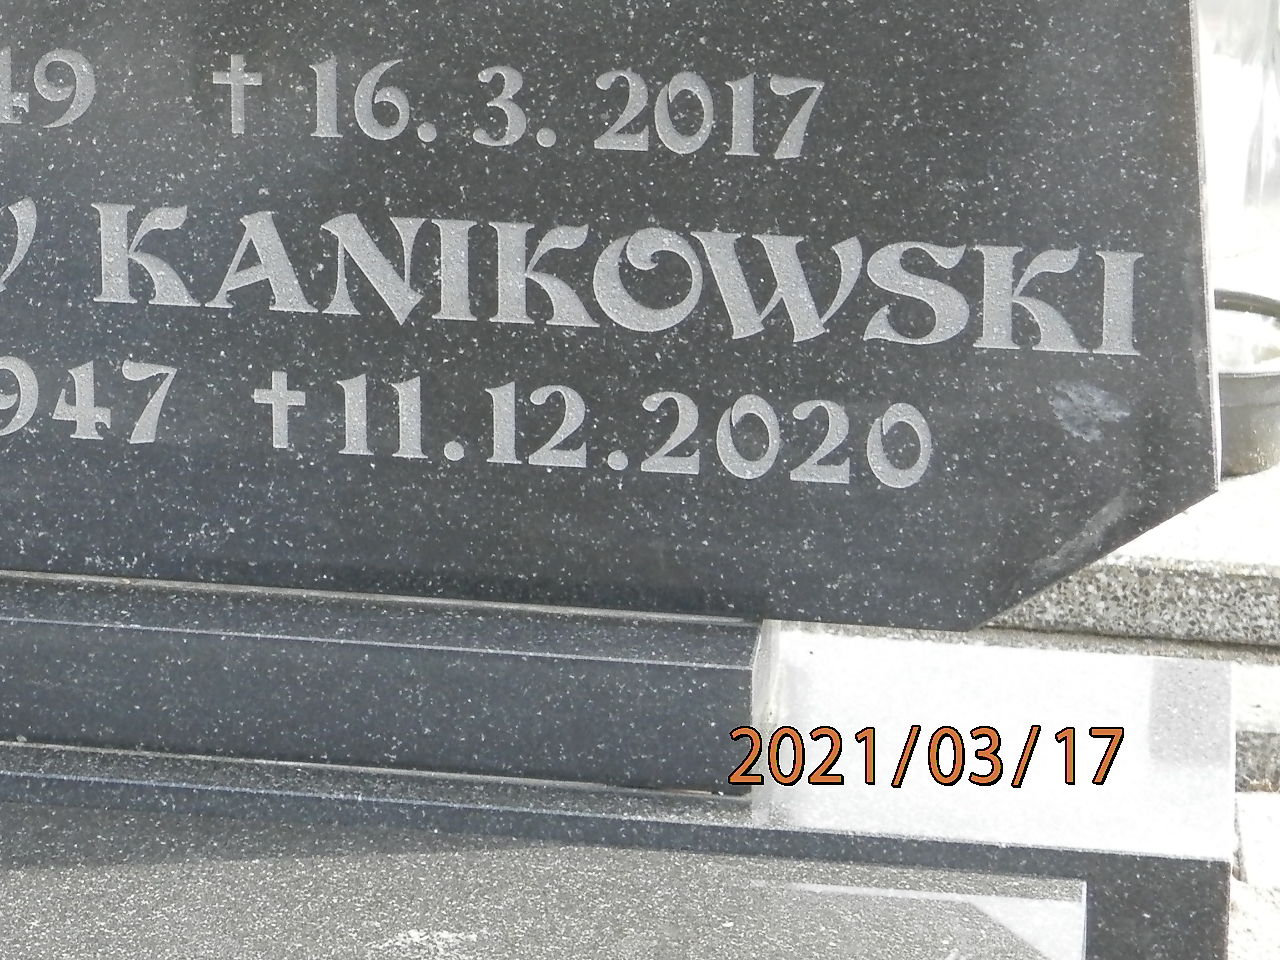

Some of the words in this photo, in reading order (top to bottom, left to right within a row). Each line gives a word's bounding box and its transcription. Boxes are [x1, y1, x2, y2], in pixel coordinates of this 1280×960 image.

[310, 57, 438, 144] 16.
[473, 63, 559, 150] 3.
[593, 68, 827, 161] 2017
[90, 202, 1143, 358] KANIKOWSKI
[337, 372, 935, 491] 11.12.2020
